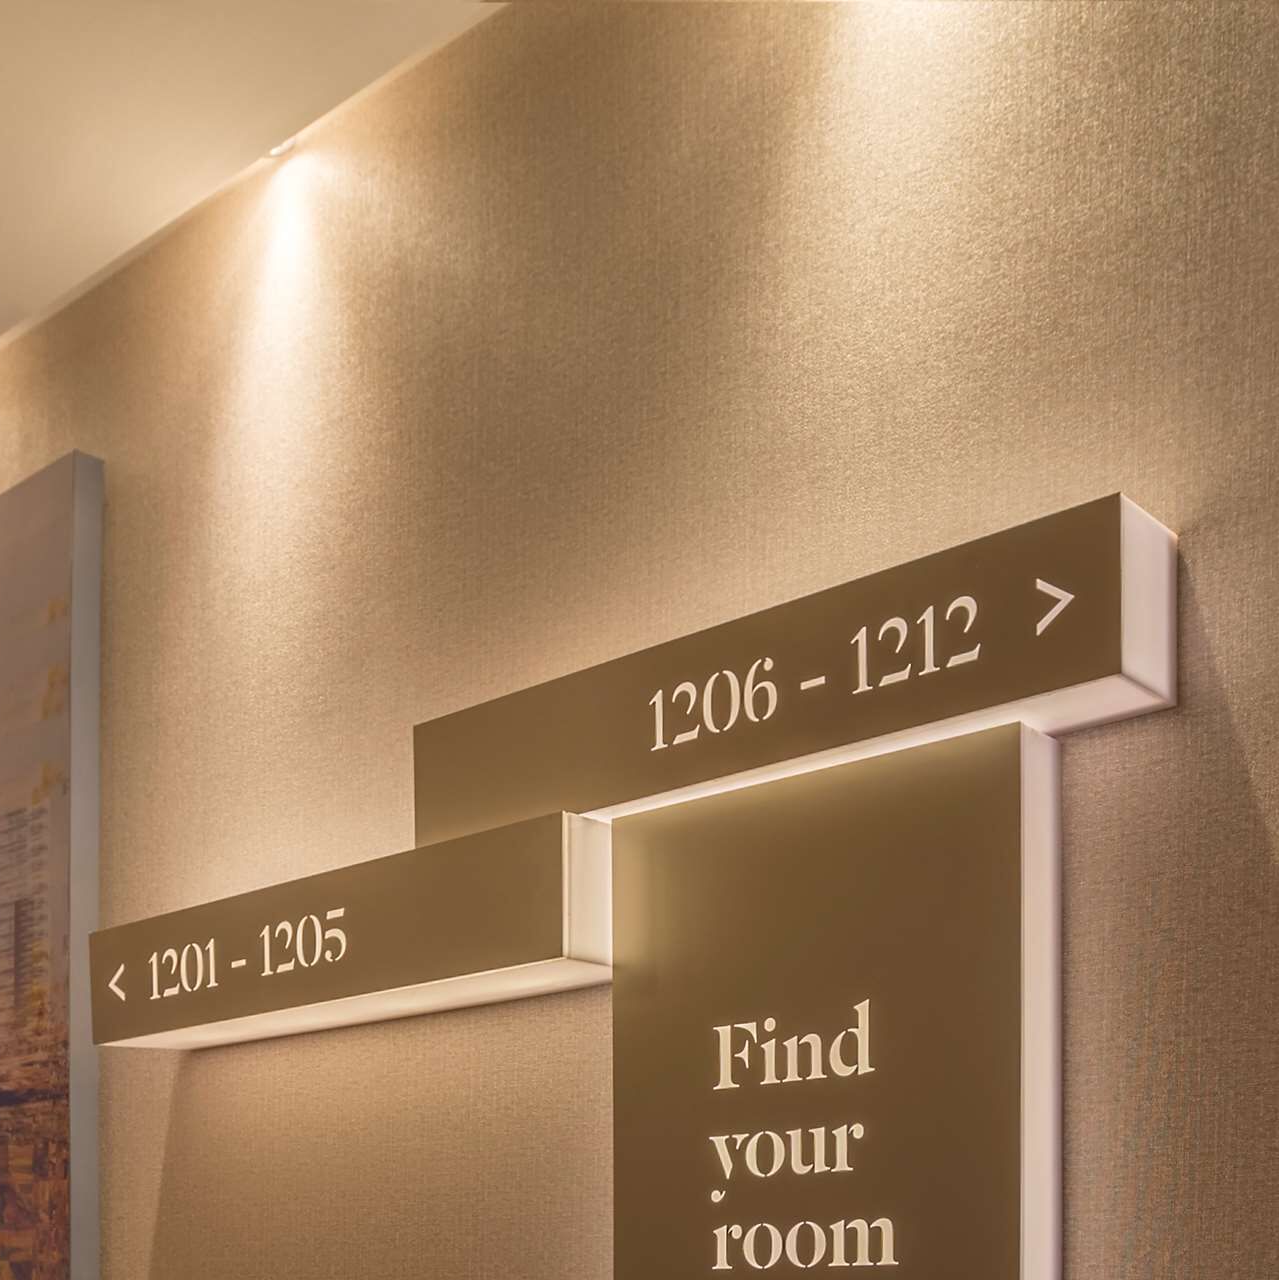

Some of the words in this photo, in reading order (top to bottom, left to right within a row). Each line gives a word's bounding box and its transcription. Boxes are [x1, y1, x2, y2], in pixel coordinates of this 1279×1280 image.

[647, 656, 778, 752] 1206
[848, 594, 982, 695] 1212
[147, 937, 219, 1000] 1201
[259, 907, 347, 977] 1205
[712, 998, 876, 1091] Find
[708, 1122, 865, 1202] your
[711, 1214, 900, 1270] room
